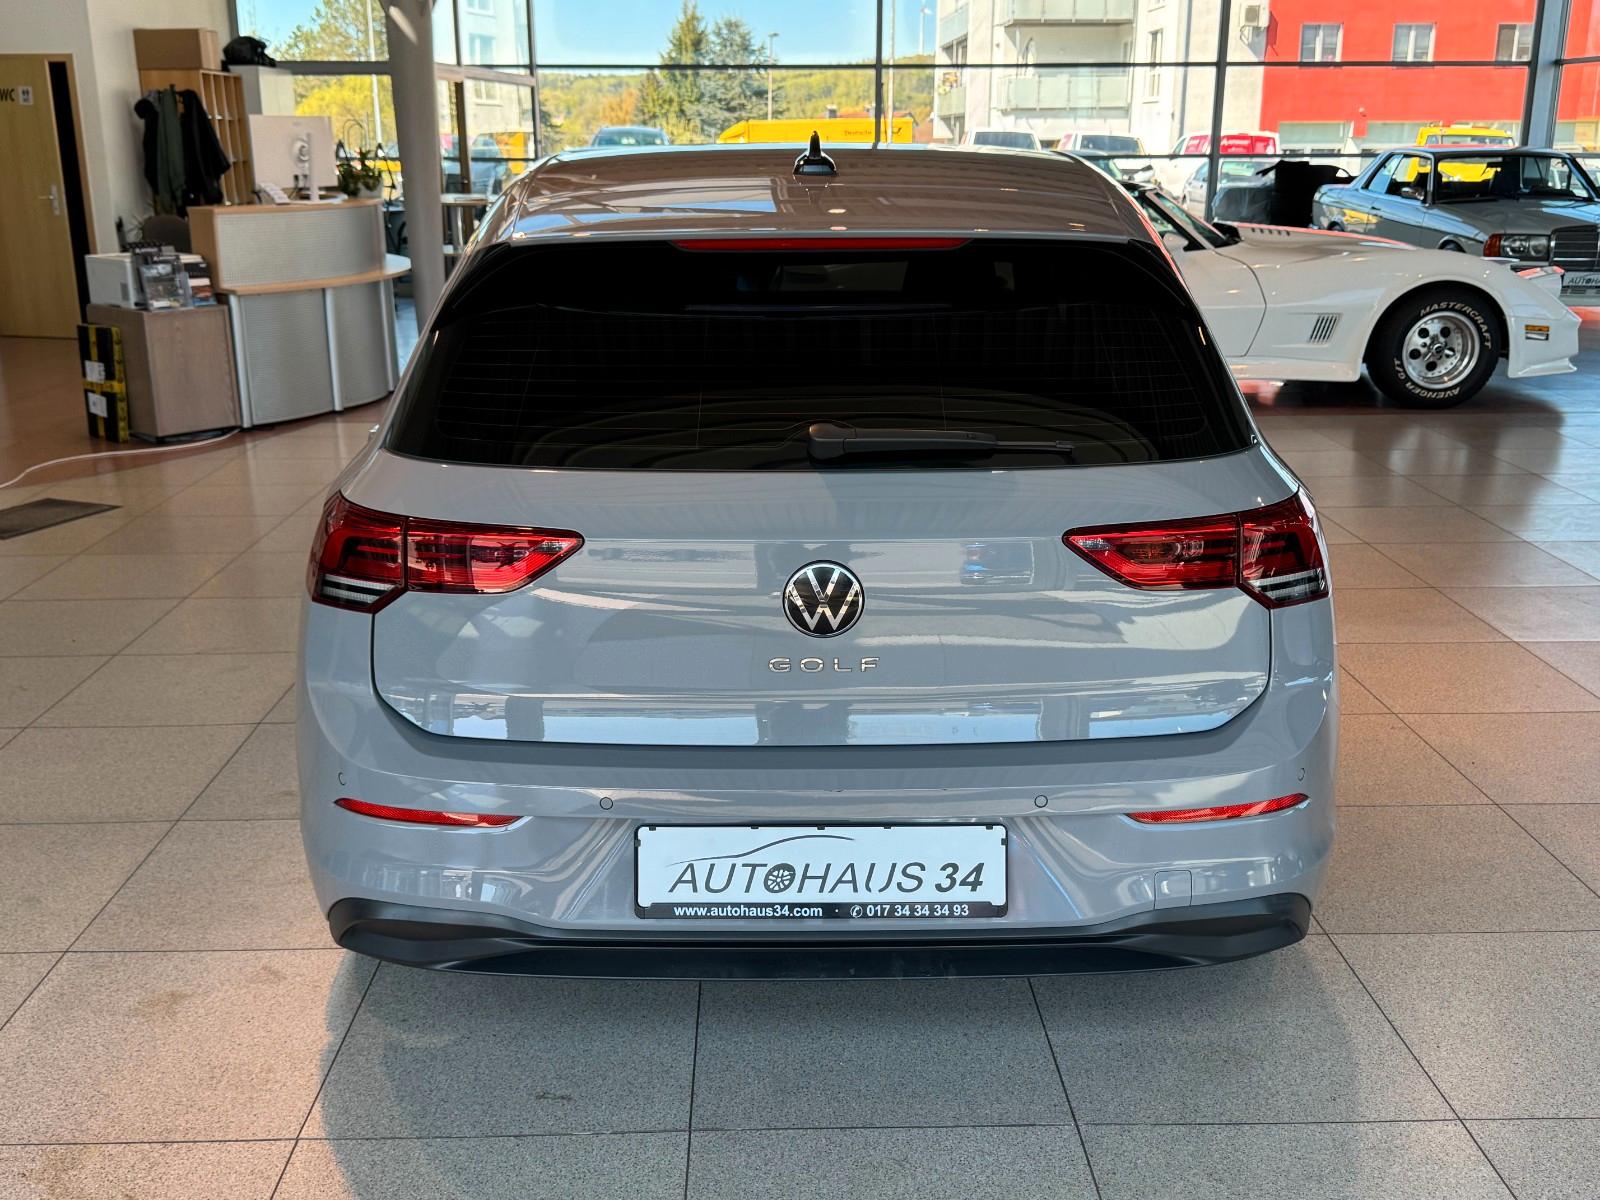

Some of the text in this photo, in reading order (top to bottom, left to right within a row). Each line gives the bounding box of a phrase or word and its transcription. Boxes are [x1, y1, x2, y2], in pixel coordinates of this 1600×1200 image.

[0, 88, 15, 102] WC
[1420, 302, 1491, 349] MASTERCRAFT
[1405, 382, 1460, 399] AVENGER
[768, 656, 880, 673] GOLF
[668, 861, 985, 894] AUTOHAUS 34
[673, 904, 823, 918] www.autohaus34.com
[866, 904, 969, 917] 017 34 34 34 93
